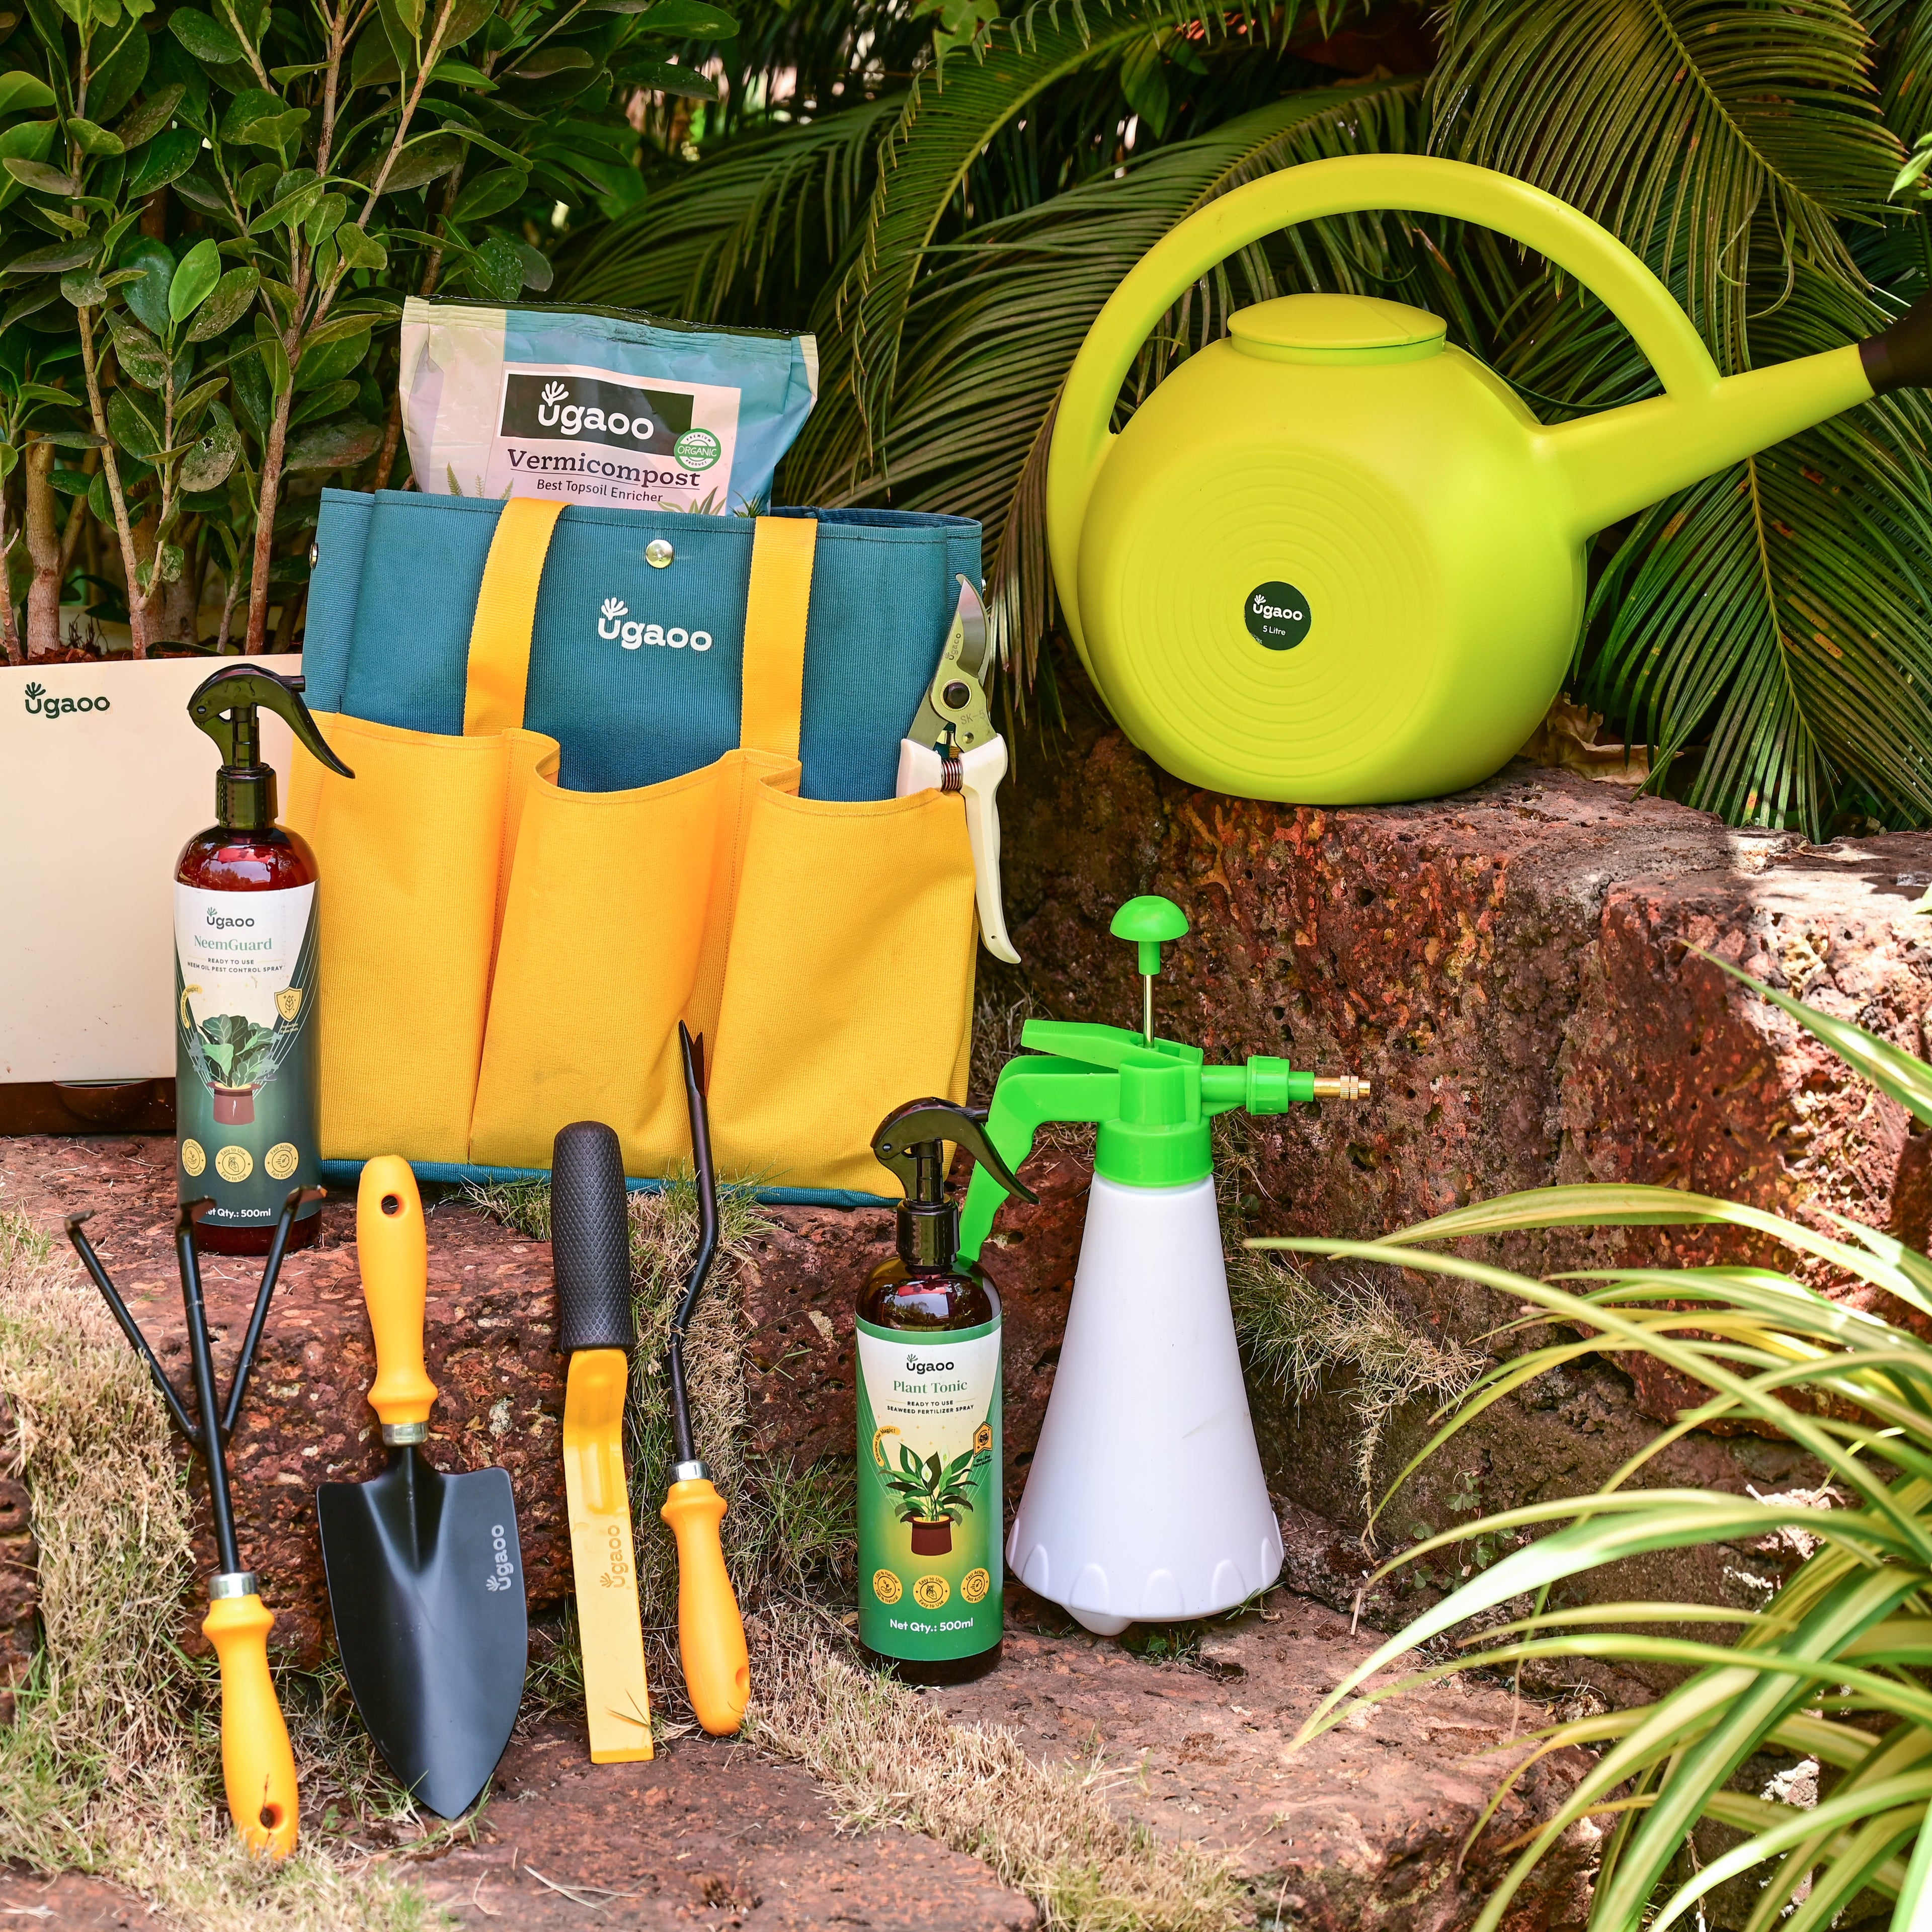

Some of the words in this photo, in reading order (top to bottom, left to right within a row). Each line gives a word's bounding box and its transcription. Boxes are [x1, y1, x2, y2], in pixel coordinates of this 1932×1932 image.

[538, 404, 654, 440] ugaoo
[686, 434, 711, 442] PREMIUM
[677, 445, 717, 457] ORGANIC
[507, 449, 701, 488] Vermicompost
[537, 479, 562, 491] Best
[566, 480, 607, 496] Topsoil
[611, 487, 664, 502] Enricher
[1252, 603, 1303, 621] ugaoo
[598, 617, 712, 651] ugaoo
[1269, 626, 1286, 635] Litre
[25, 696, 110, 719] ugaoo
[206, 916, 255, 930] ugaoo
[194, 935, 273, 951] NeemGuard
[270, 1147, 279, 1155] Fast
[221, 1171, 230, 1180] Easy
[280, 1169, 294, 1178] Acting
[206, 1208, 216, 1216] et
[217, 1208, 239, 1219] Qty.:
[240, 1208, 271, 1218] 500ml
[906, 1361, 954, 1375] ugaoo
[893, 1380, 928, 1394] Plant
[931, 1380, 968, 1394] Tonic
[887, 1405, 916, 1414] SEAWEED
[955, 1404, 974, 1412] SPRAY
[491, 1524, 514, 1591] ugaoo
[607, 1524, 629, 1588] ugaoo
[885, 1571, 899, 1584] Natural
[965, 1573, 974, 1581] Fast
[885, 1594, 899, 1603] Natural
[974, 1592, 986, 1601] Acting
[919, 1599, 929, 1608] Easy
[890, 1618, 908, 1631] Net
[910, 1622, 937, 1634] Qty.:
[939, 1617, 974, 1632] 500ml
